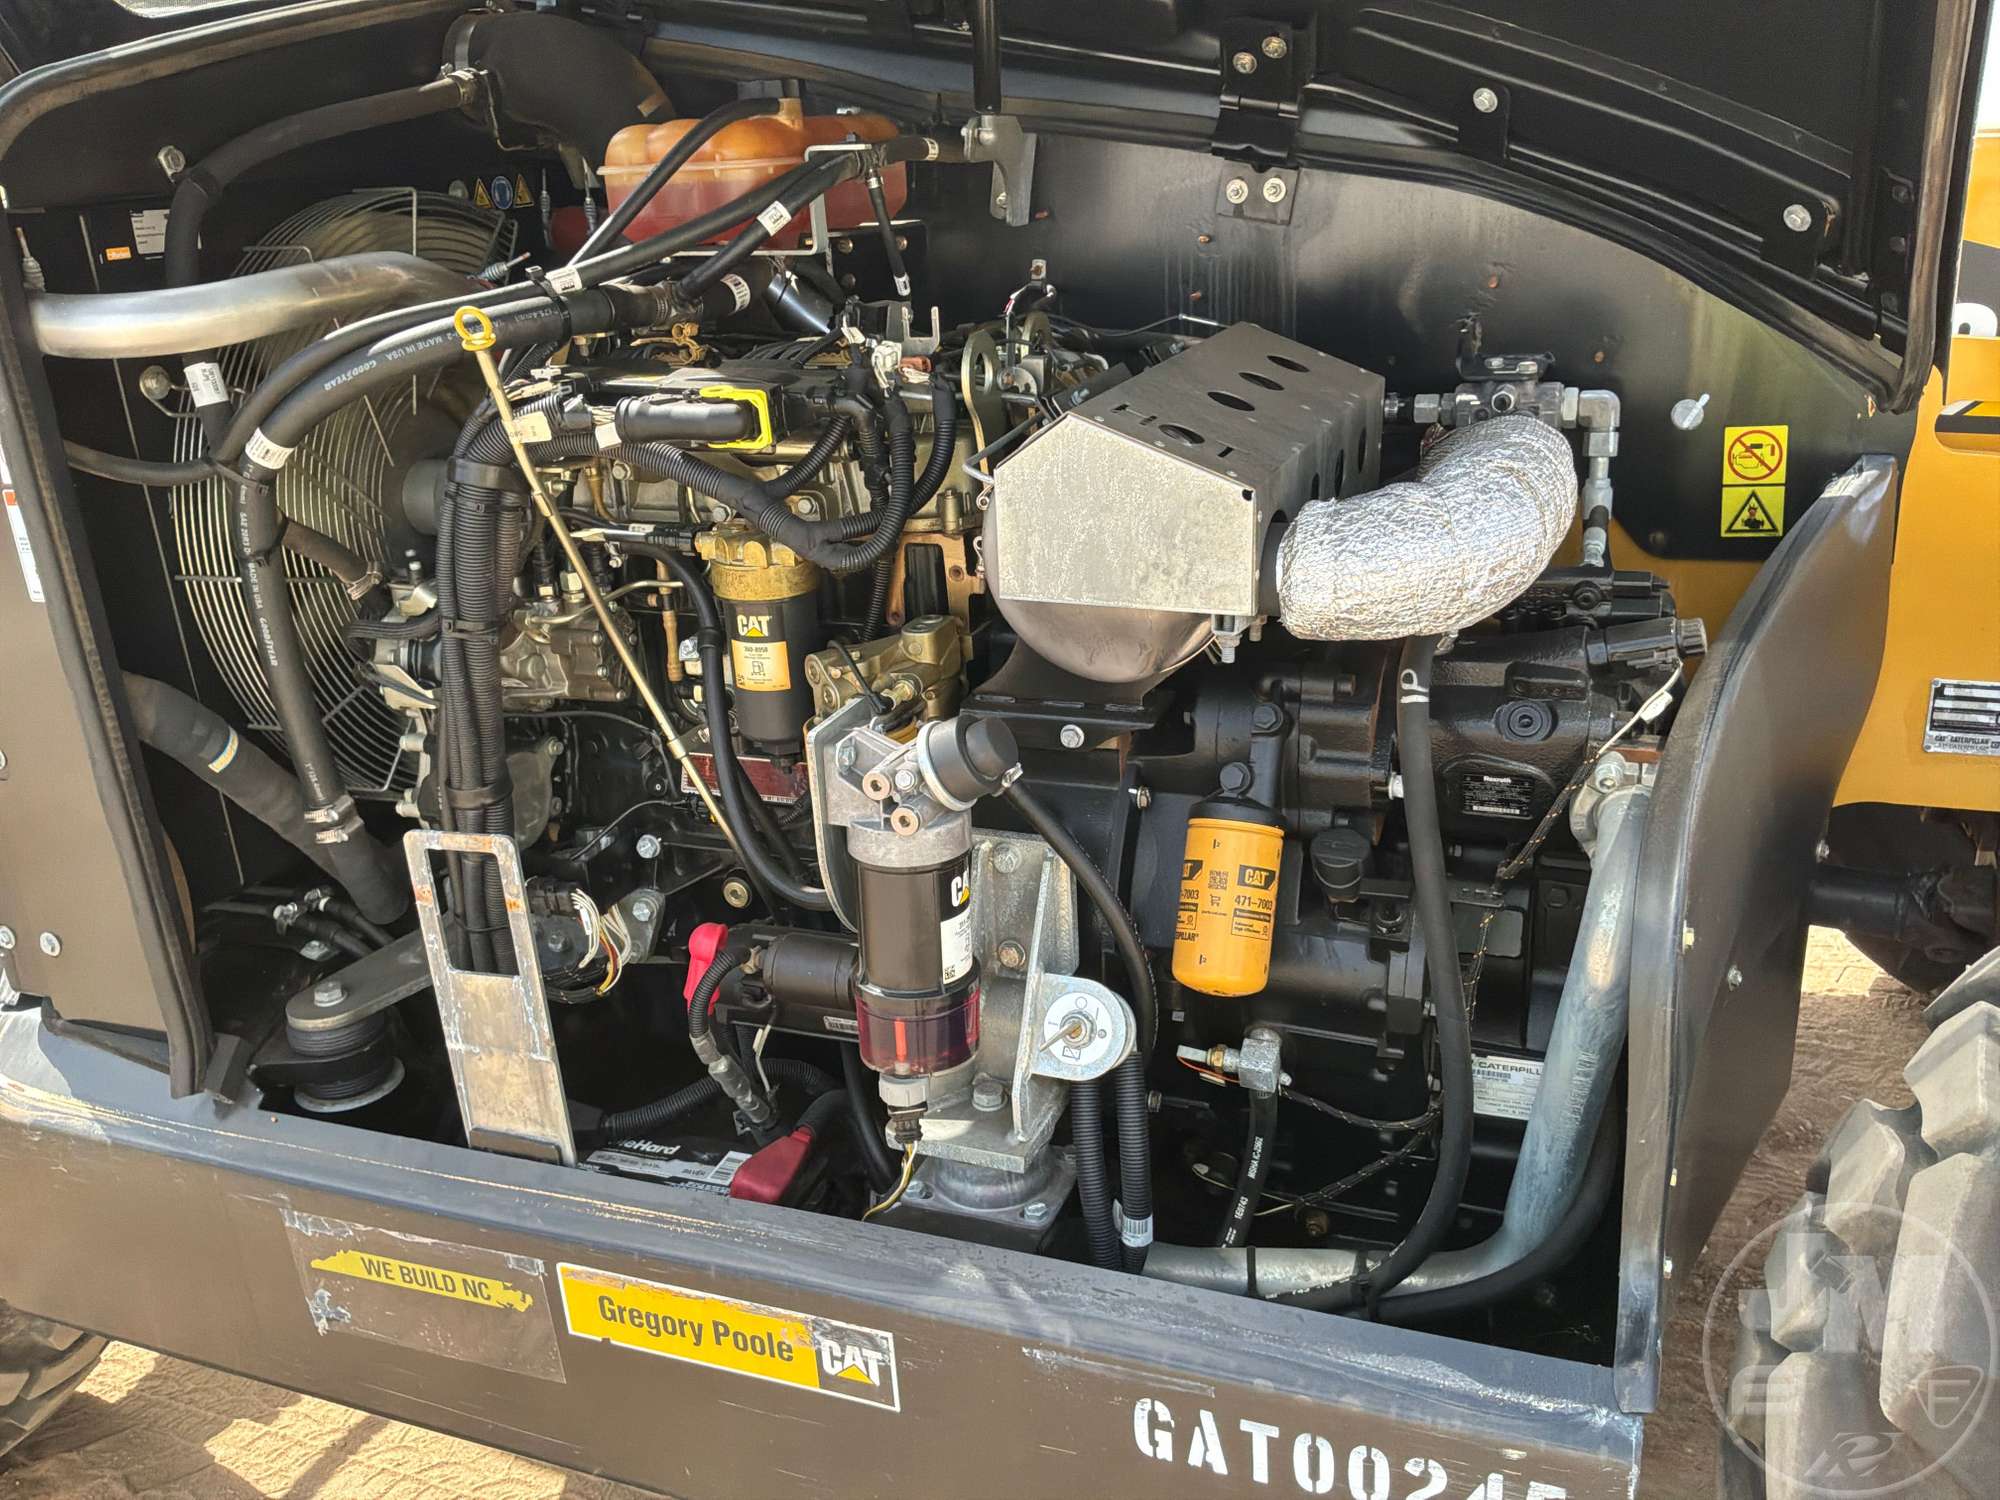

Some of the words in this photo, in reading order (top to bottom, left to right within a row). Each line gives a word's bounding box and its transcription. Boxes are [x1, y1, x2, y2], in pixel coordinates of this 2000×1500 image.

[323, 359, 378, 391] GOODYEAR
[736, 614, 770, 637] CAT
[259, 617, 279, 667] GOODYEAR
[1244, 868, 1270, 887] CAT
[1478, 1061, 1543, 1076] CATERPILL
[360, 1256, 396, 1281] WE
[399, 1263, 457, 1293] BUILD
[462, 1278, 492, 1301] NC
[598, 1295, 704, 1347] Gregory
[712, 1320, 794, 1363] Poole
[819, 1339, 886, 1387] CAT
